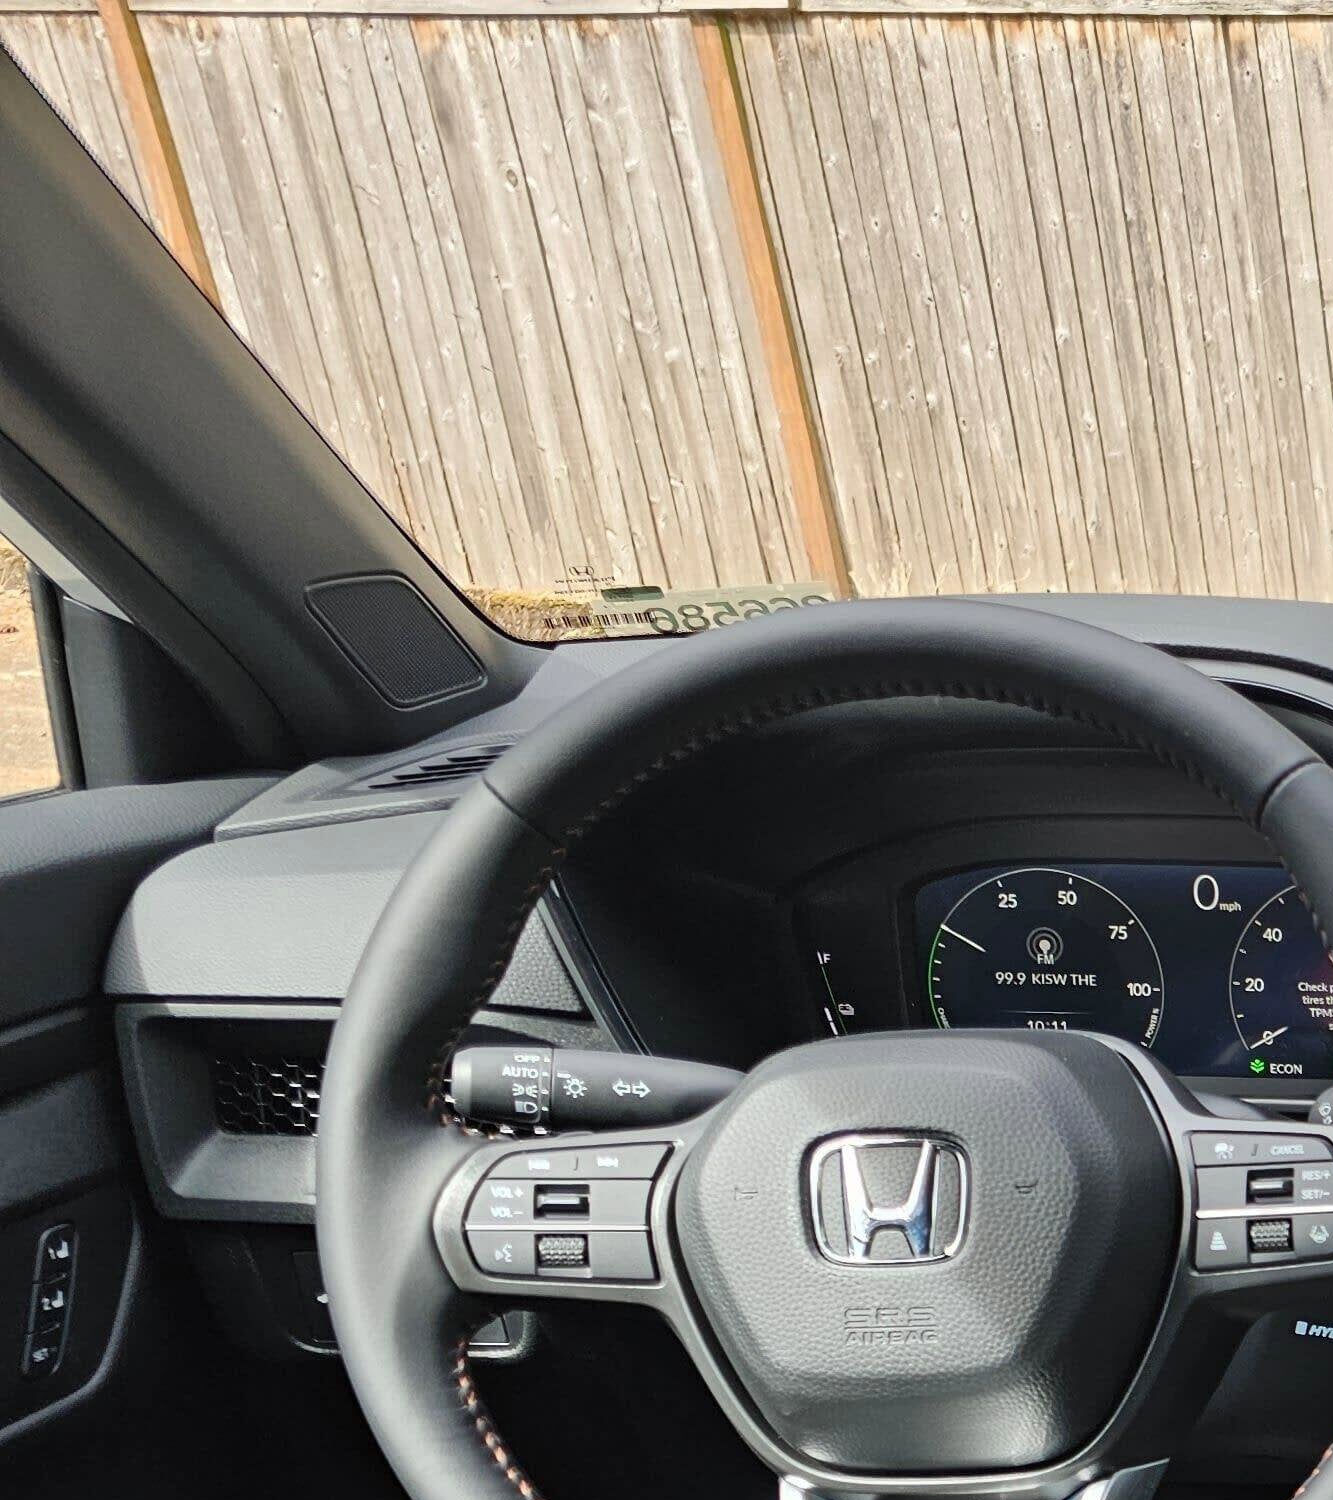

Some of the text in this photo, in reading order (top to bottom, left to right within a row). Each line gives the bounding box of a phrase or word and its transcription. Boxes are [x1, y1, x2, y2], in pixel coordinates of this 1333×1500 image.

[997, 893, 1018, 909] 25
[1057, 890, 1078, 906] 50
[1192, 874, 1242, 913] 0 mph
[1108, 924, 1129, 941] 75
[1262, 927, 1283, 943] 40
[823, 953, 831, 964] F
[1036, 953, 1055, 966] FM
[994, 971, 1098, 987] 99.9 KISW THE
[1244, 977, 1265, 993] 20
[1297, 981, 1329, 993] Check
[1126, 982, 1152, 997] 100
[1302, 995, 1325, 1006] tires
[502, 1065, 539, 1079] AUTO
[1269, 1063, 1303, 1075] ECON
[843, 1306, 937, 1326] SRS
